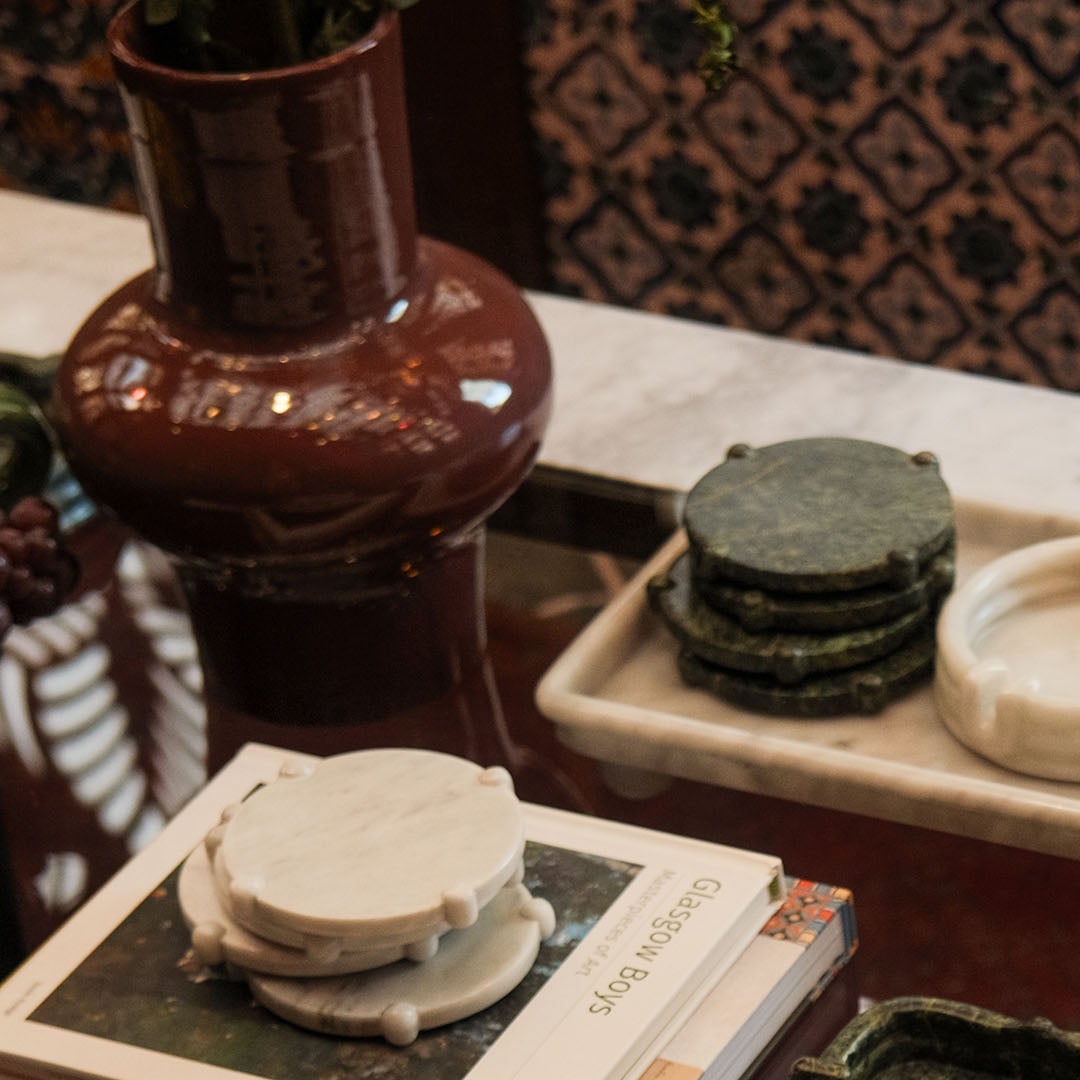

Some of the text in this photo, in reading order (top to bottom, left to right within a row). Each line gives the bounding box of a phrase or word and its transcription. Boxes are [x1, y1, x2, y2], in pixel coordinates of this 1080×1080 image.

[605, 868, 677, 941] Masterpieces
[636, 877, 722, 962] Glasgow
[589, 966, 649, 1016] Boys
